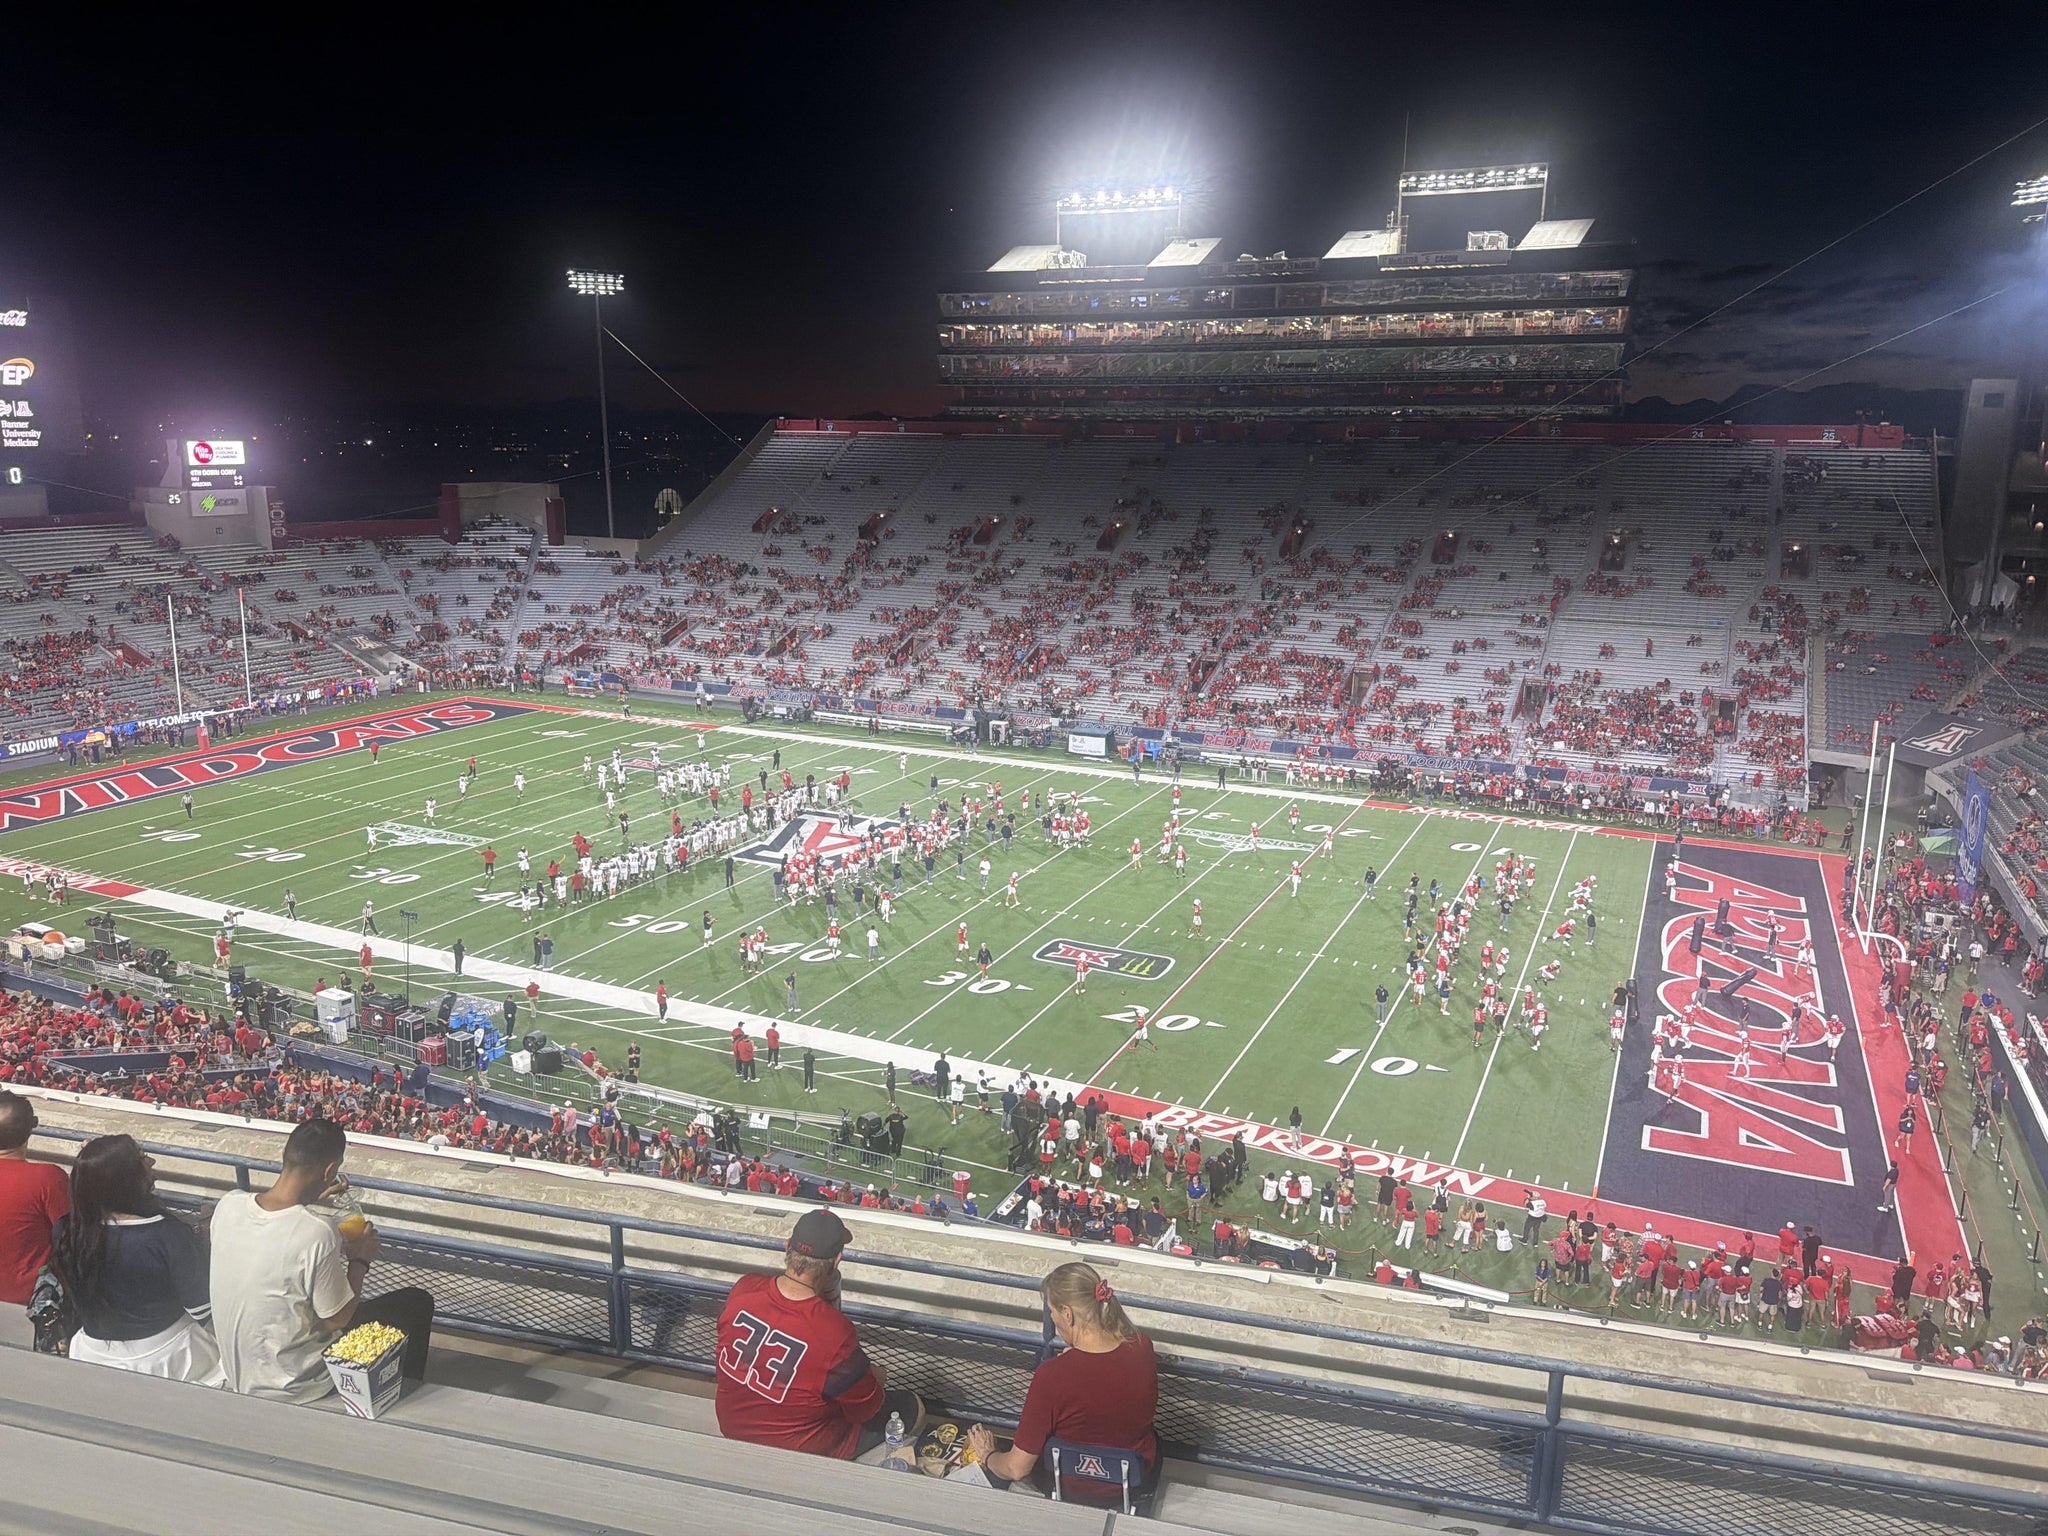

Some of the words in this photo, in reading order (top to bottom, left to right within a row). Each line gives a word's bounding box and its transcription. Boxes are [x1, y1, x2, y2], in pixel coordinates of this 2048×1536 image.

[0, 366, 31, 386] EP
[1, 420, 29, 429] Banner
[2, 429, 41, 439] University
[1691, 430, 1704, 439] 24
[4, 439, 39, 447] Medicine
[1822, 431, 1836, 441] 25
[168, 494, 181, 504] 25
[7, 734, 59, 756] STADIUM
[1203, 733, 1272, 753] REDLINE
[1353, 749, 1408, 764] ARIZONA
[1406, 754, 1478, 771] FOOTBALL
[1566, 768, 1651, 790] REDLINE
[234, 846, 306, 863] 20
[350, 868, 422, 884] 30
[607, 914, 689, 934] 50
[922, 970, 1012, 994] 30
[1641, 861, 1855, 1187] ARIZONA
[1323, 1047, 1420, 1077] 10
[718, 1309, 809, 1404] 33
[340, 1373, 361, 1395] A
[1074, 1453, 1110, 1479] A
